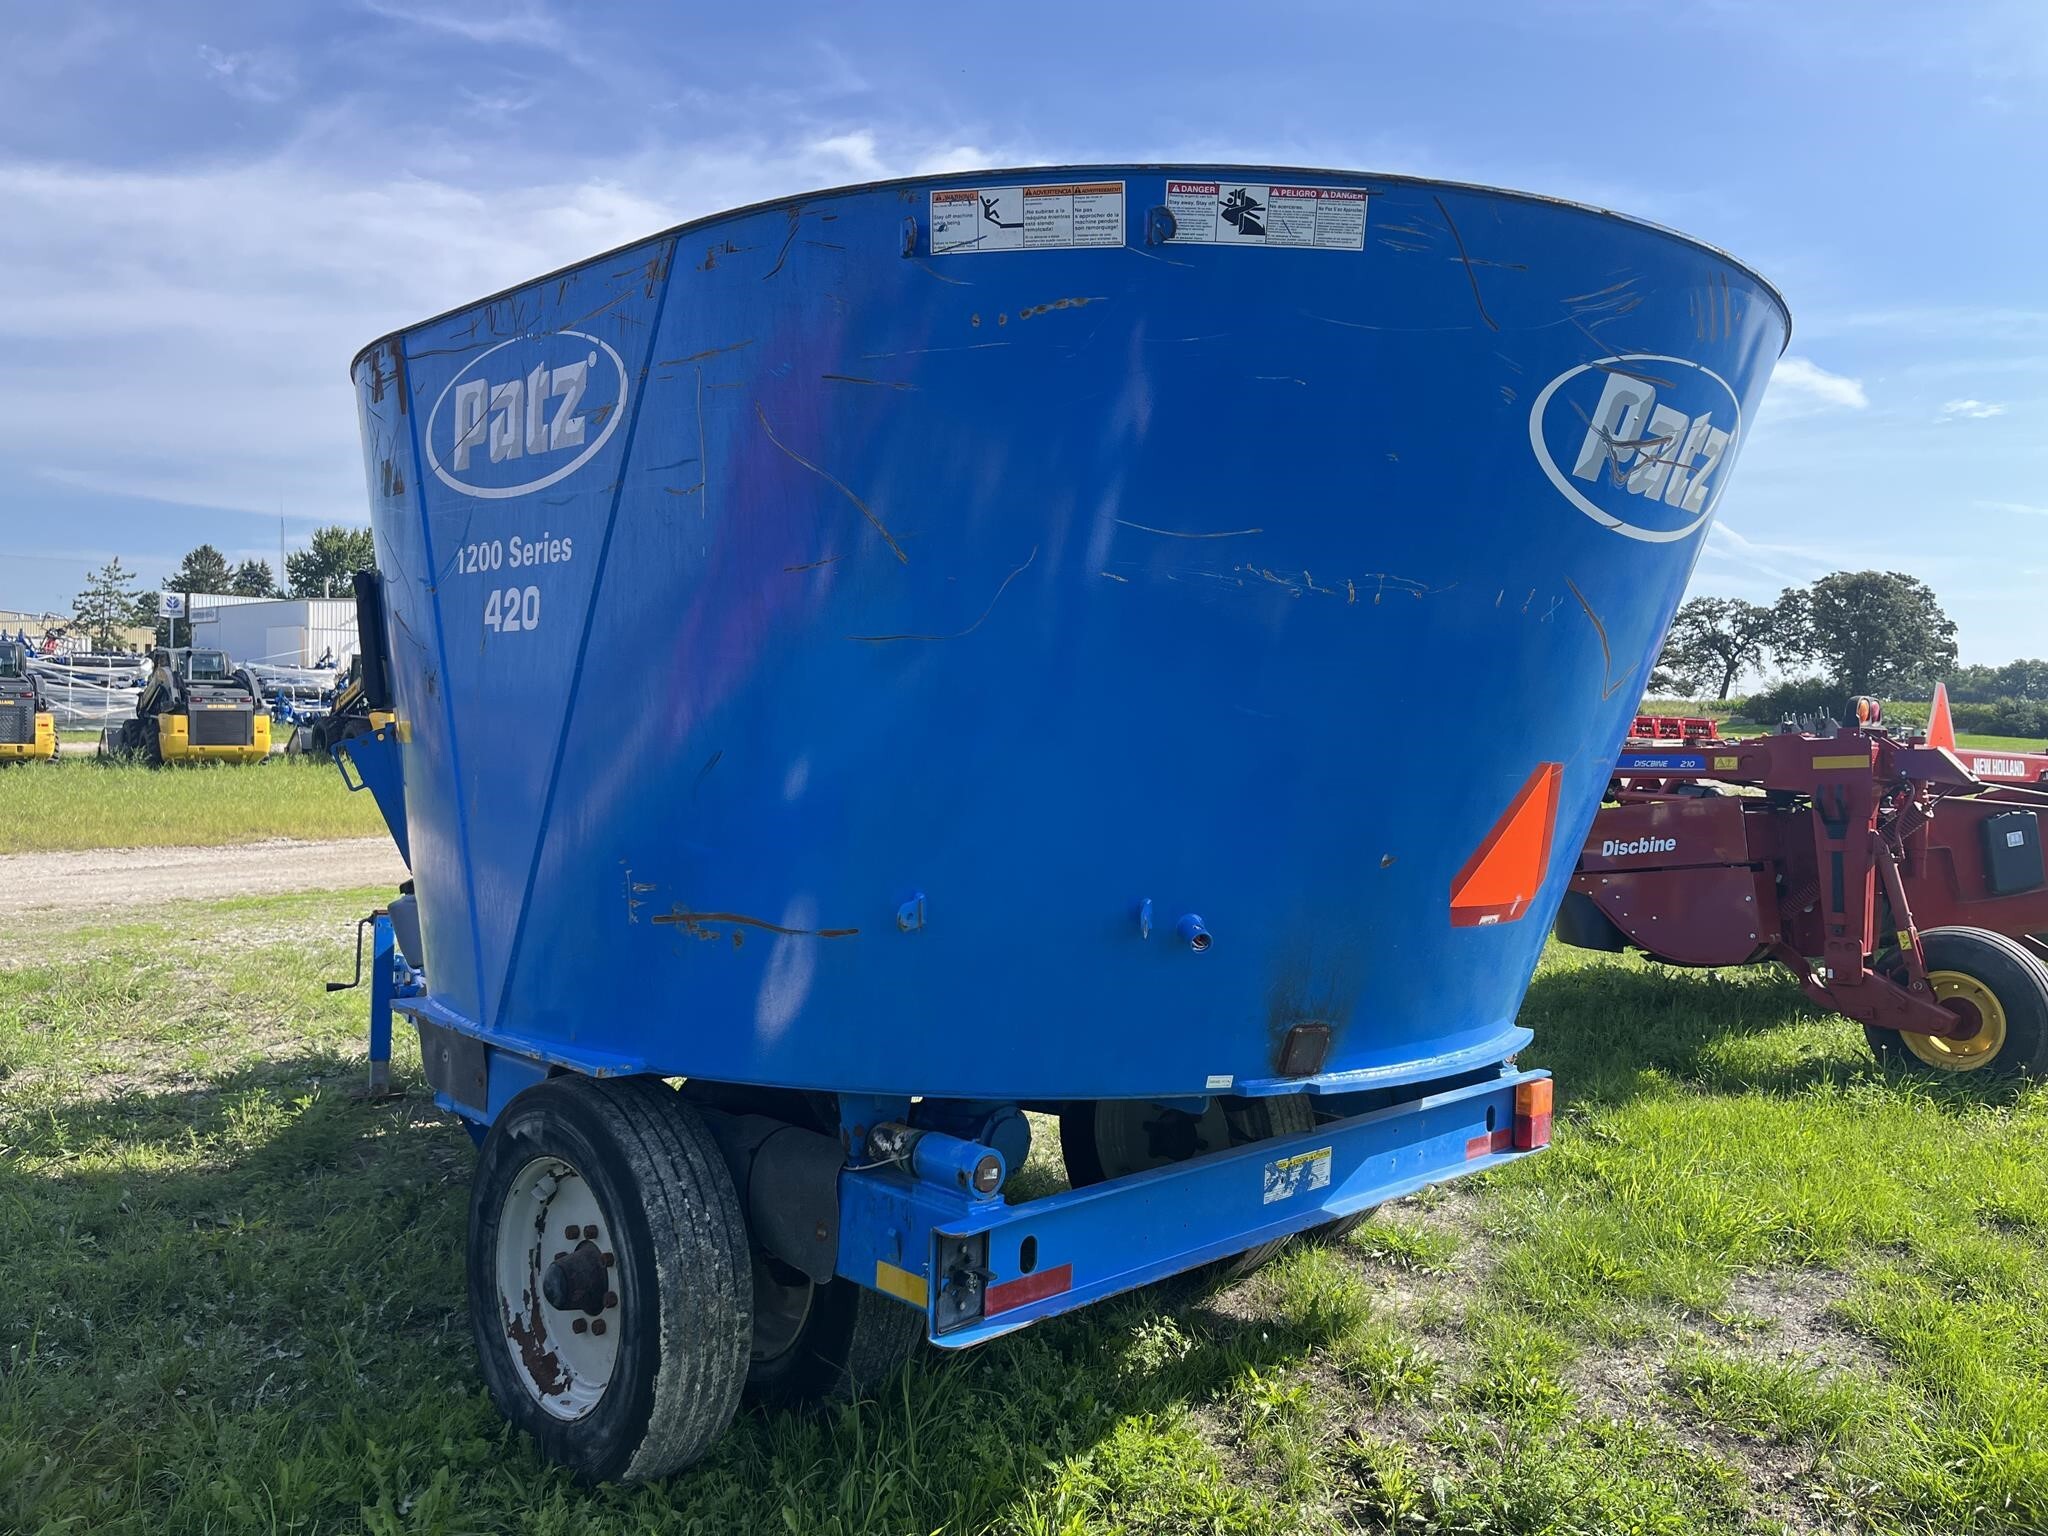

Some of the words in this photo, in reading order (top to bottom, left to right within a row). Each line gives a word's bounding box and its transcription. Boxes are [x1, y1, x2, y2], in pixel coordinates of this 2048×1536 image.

[1032, 187, 1072, 196] ADVERTENCIA
[1181, 185, 1216, 194] DANGER
[1281, 189, 1317, 198] PELIGRO
[454, 360, 588, 472] Patz
[1572, 372, 1730, 514] Patz
[456, 540, 503, 574] 1200
[508, 531, 573, 568] Series
[484, 586, 541, 632] 420
[1973, 758, 1992, 775] NEW
[1992, 759, 2025, 777] HOLLAND
[1602, 836, 1677, 856] Discbine
